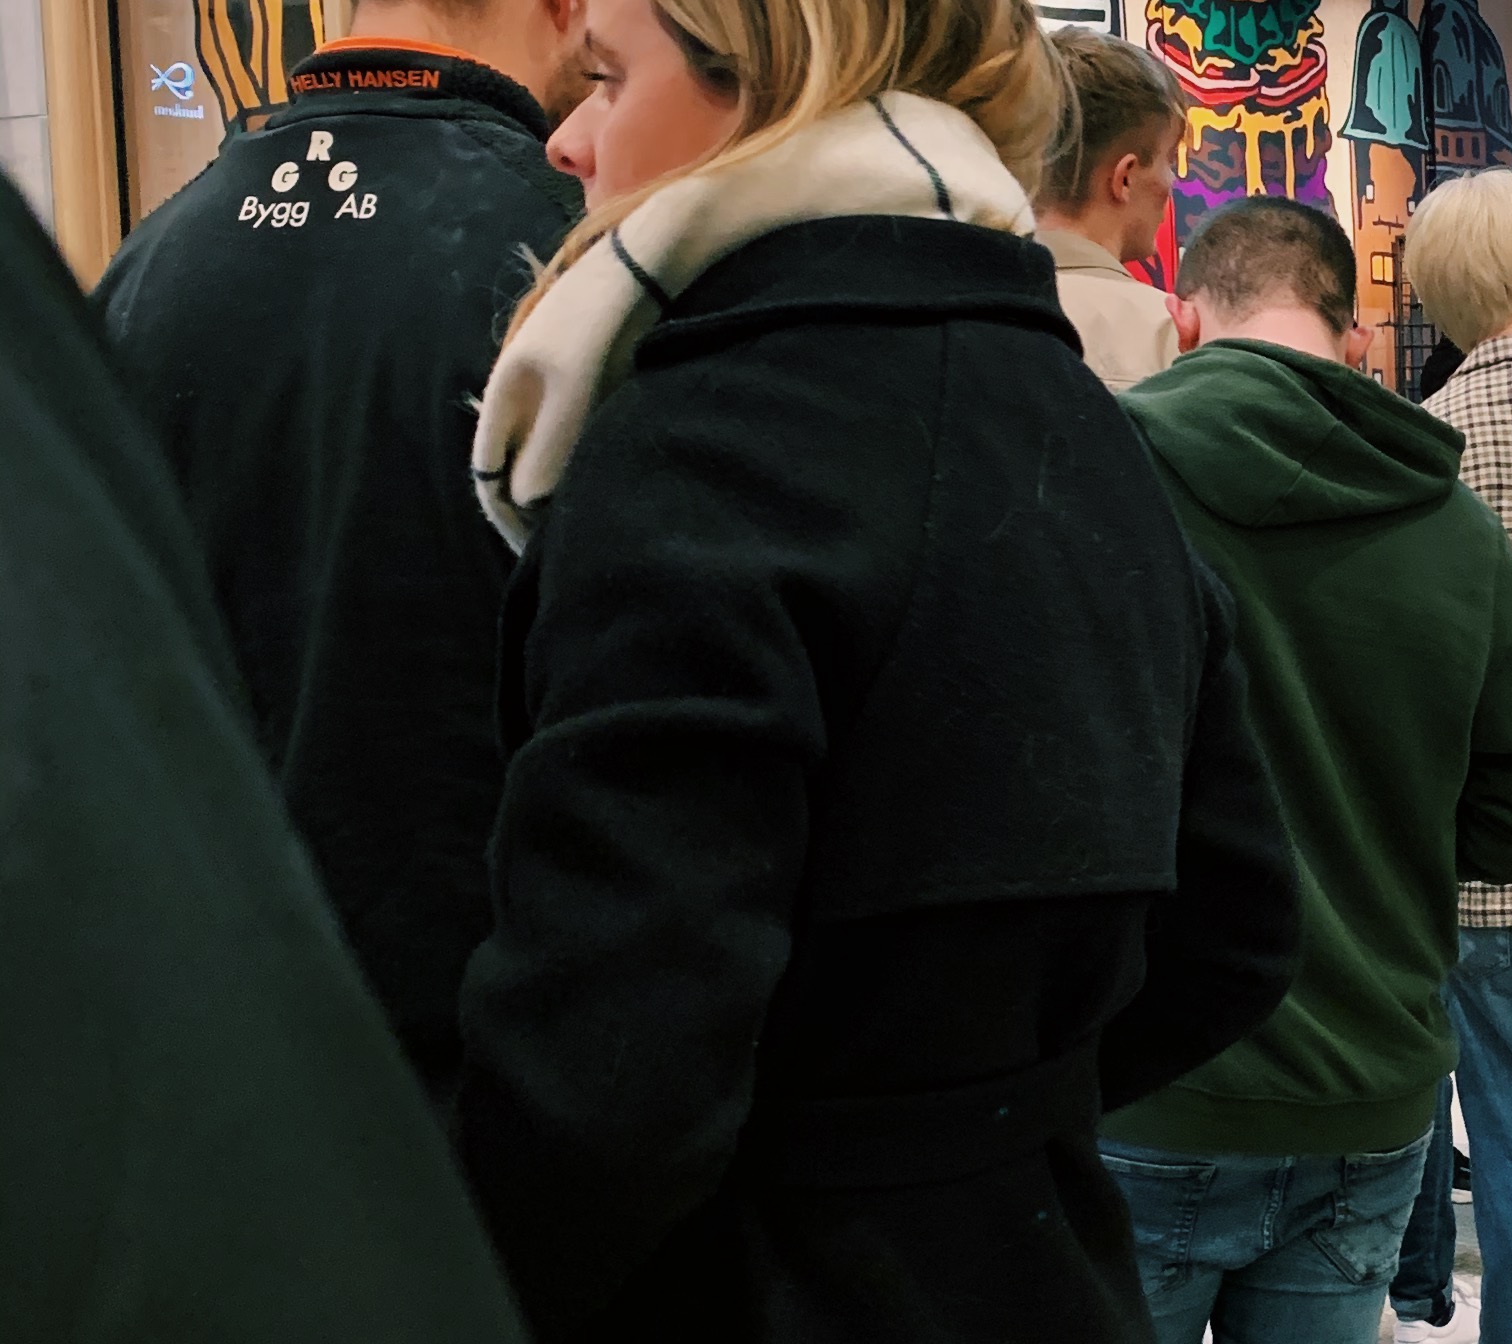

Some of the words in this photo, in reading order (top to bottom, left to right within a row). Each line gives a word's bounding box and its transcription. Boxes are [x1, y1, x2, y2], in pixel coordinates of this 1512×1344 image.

[290, 70, 342, 94] HELLY
[348, 69, 440, 89] HANSEN
[306, 130, 334, 162] R
[271, 161, 300, 193] G
[327, 160, 358, 192] G
[238, 195, 310, 228] Bygg
[334, 193, 378, 219] AB
